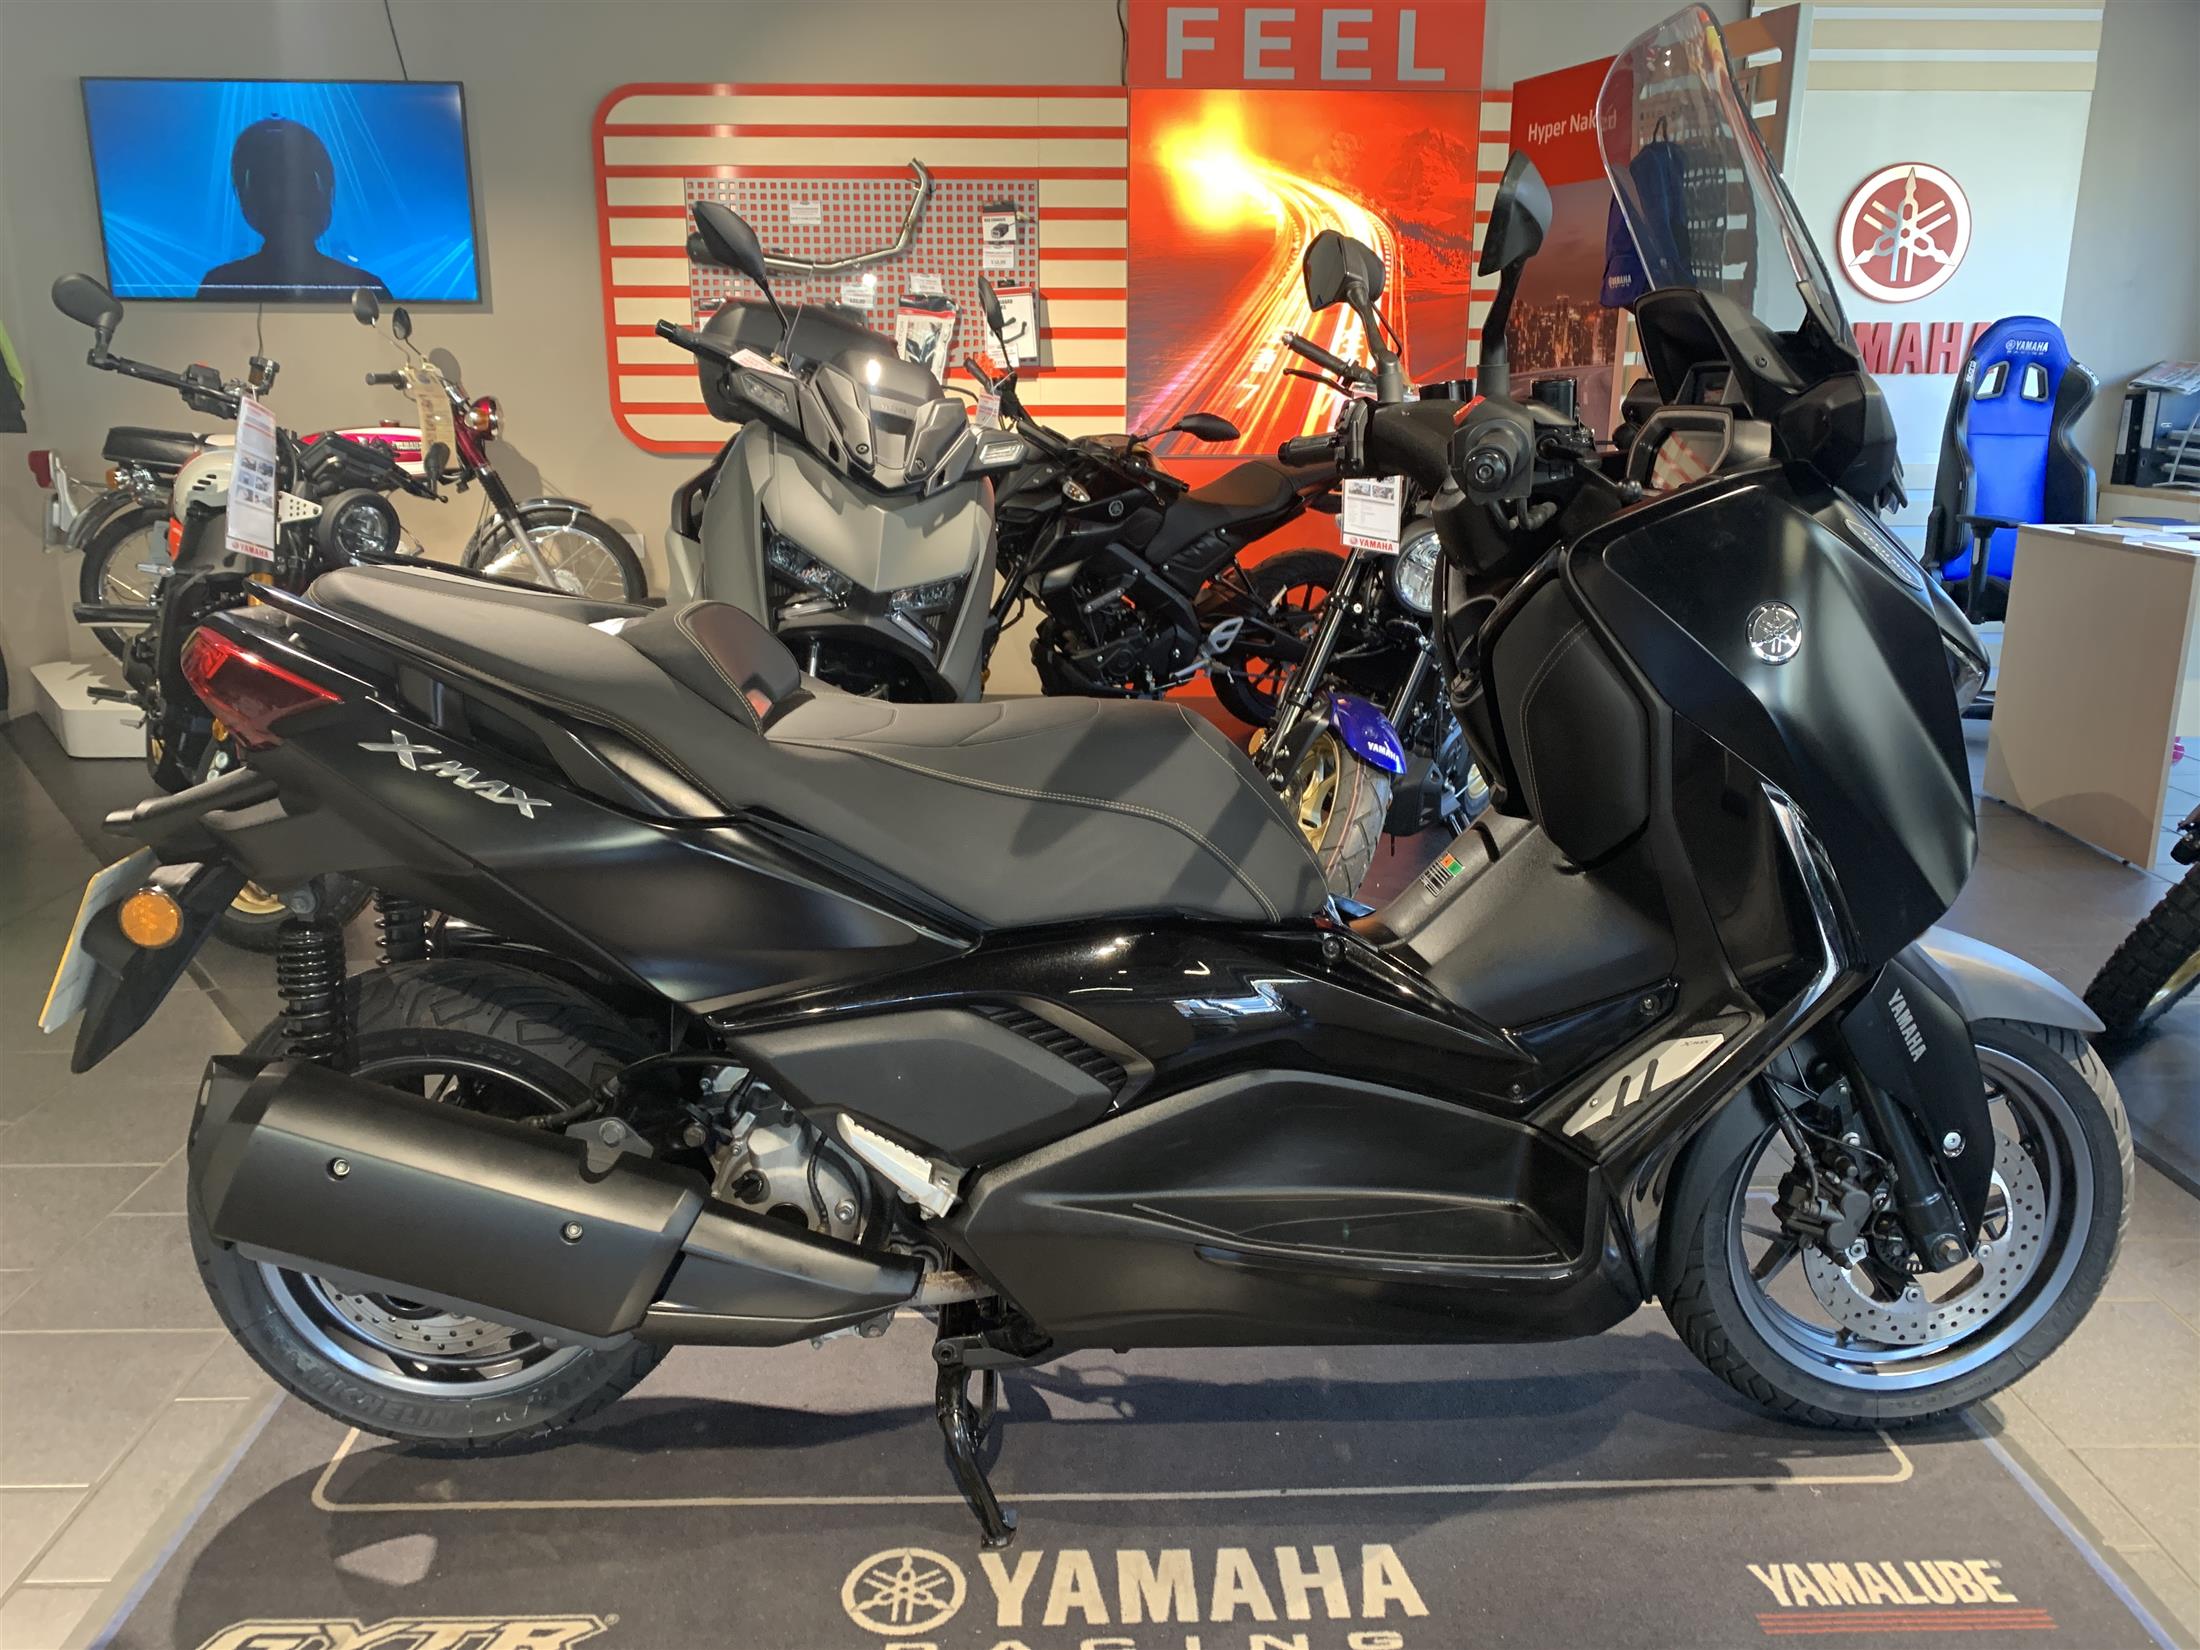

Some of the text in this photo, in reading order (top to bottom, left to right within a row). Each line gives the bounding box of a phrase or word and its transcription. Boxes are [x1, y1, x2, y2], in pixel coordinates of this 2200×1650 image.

[1166, 7, 1446, 81] FEEL
[1528, 120, 1568, 145] Hyper
[1852, 321, 1993, 374] MAH
[2015, 341, 2049, 353] YAMAHA
[240, 542, 270, 559] YAMAHA
[1359, 538, 1394, 552] YAMAHA
[1888, 987, 1928, 1063] YAMAHA
[978, 1544, 1430, 1627] YAMAHA
[1746, 1559, 2019, 1607] YAMALUBE
